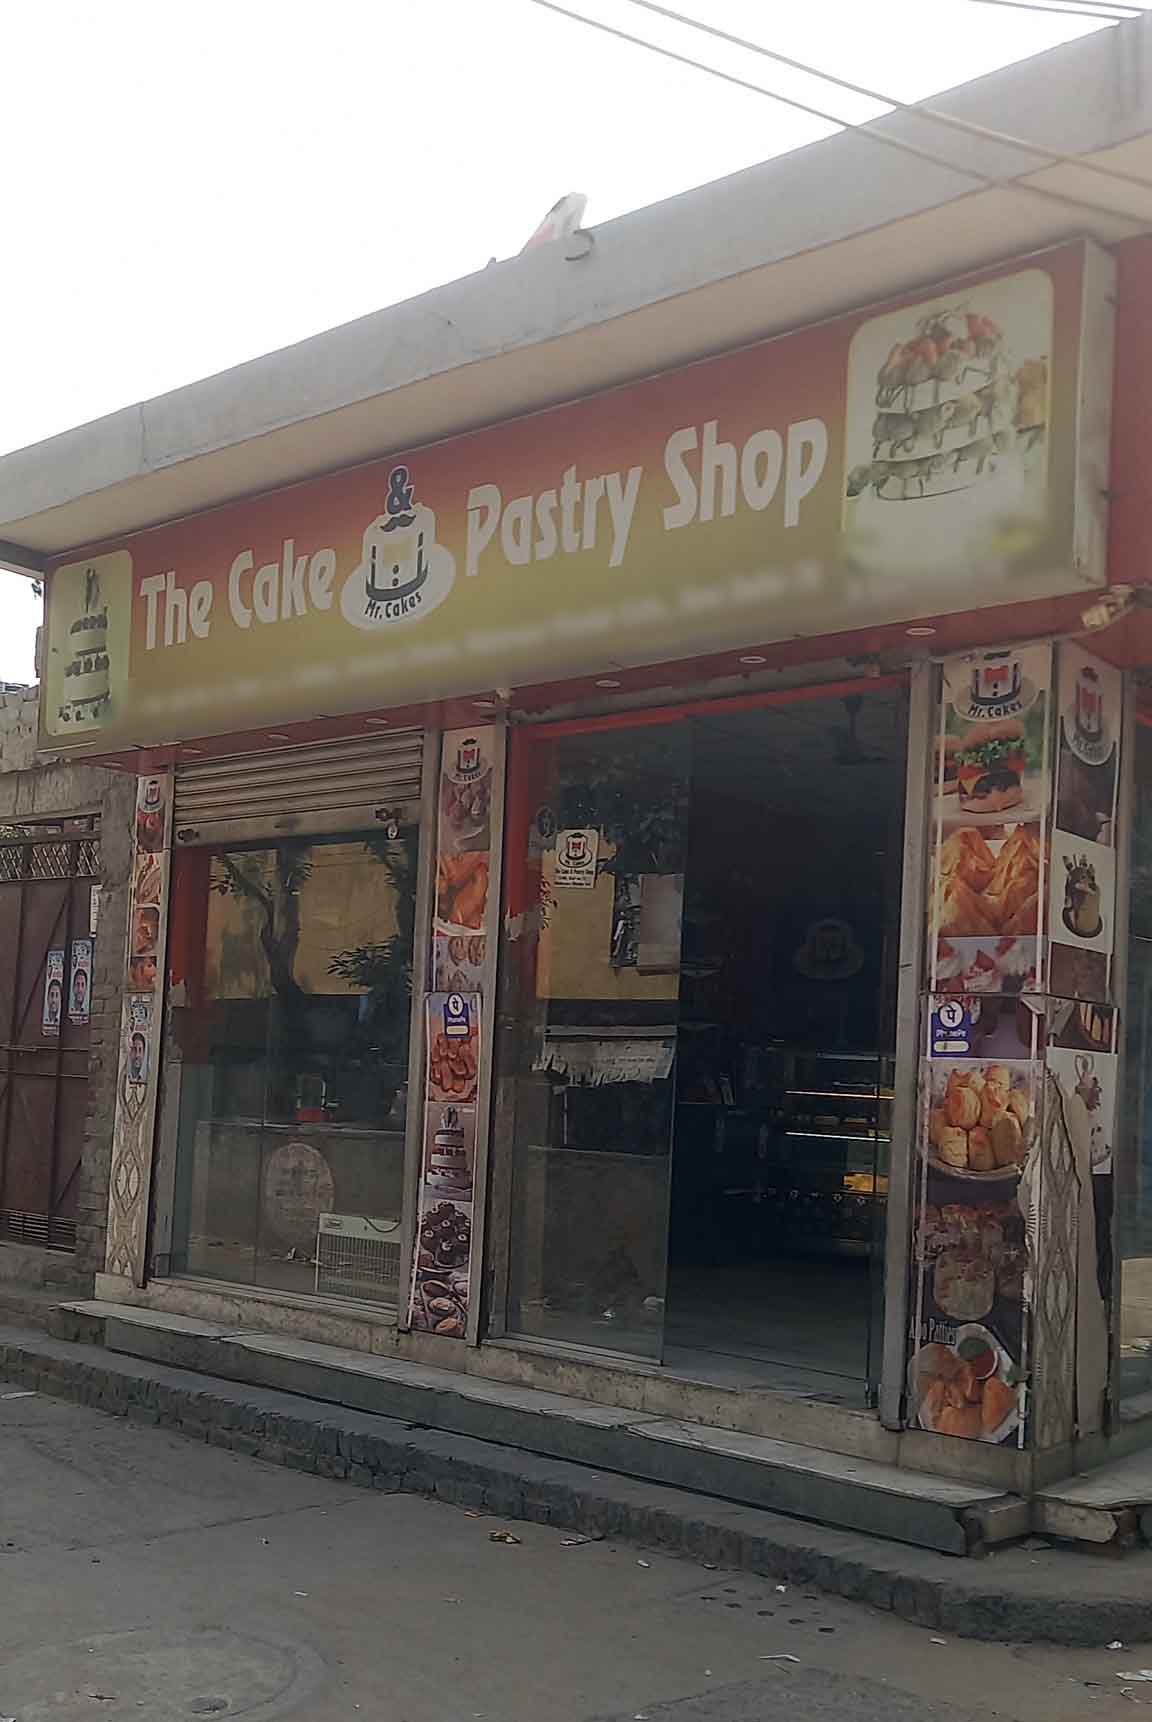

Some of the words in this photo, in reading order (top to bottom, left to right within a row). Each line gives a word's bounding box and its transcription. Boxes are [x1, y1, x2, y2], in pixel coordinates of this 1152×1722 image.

[139, 570, 214, 650] The
[228, 538, 337, 629] Cake
[387, 466, 414, 515] &
[465, 464, 643, 577] Pastry
[663, 418, 829, 530] Shop
[364, 599, 383, 620] Mr.
[385, 591, 422, 618] Cakes
[967, 703, 985, 718] Mr.
[987, 701, 1023, 718] Cakes
